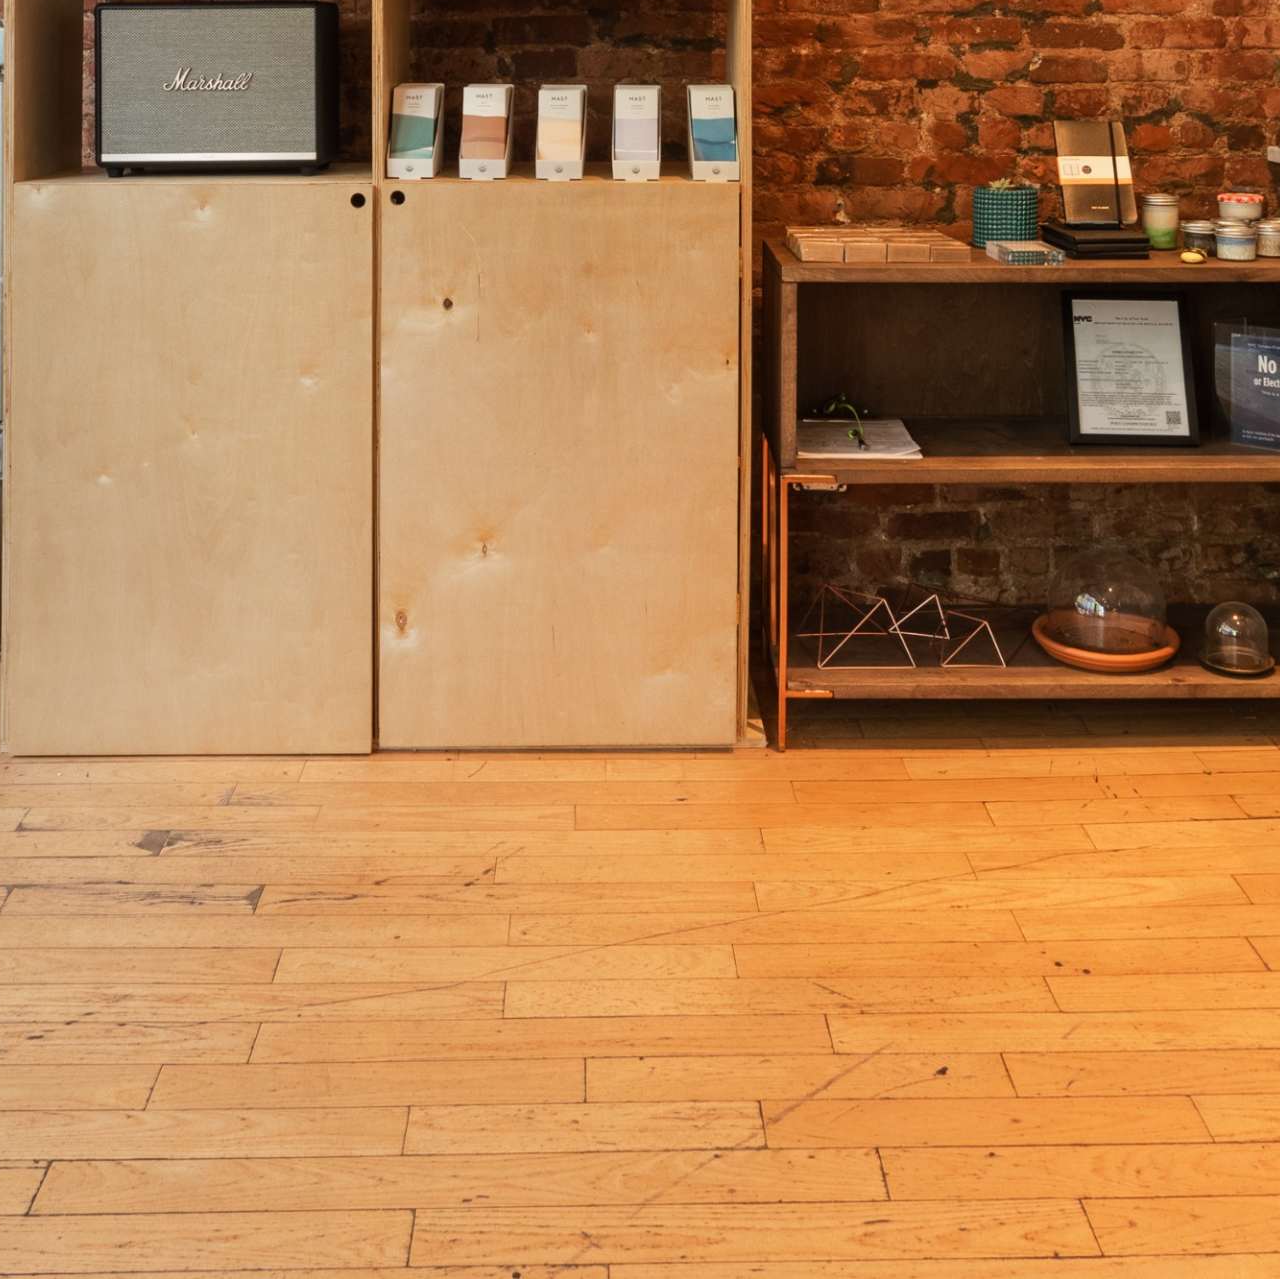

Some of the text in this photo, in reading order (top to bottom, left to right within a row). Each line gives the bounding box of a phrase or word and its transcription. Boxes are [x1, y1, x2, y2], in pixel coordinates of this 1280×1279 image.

[164, 67, 253, 91] Marshall
[1258, 355, 1276, 374] No
[1254, 378, 1261, 386] or
